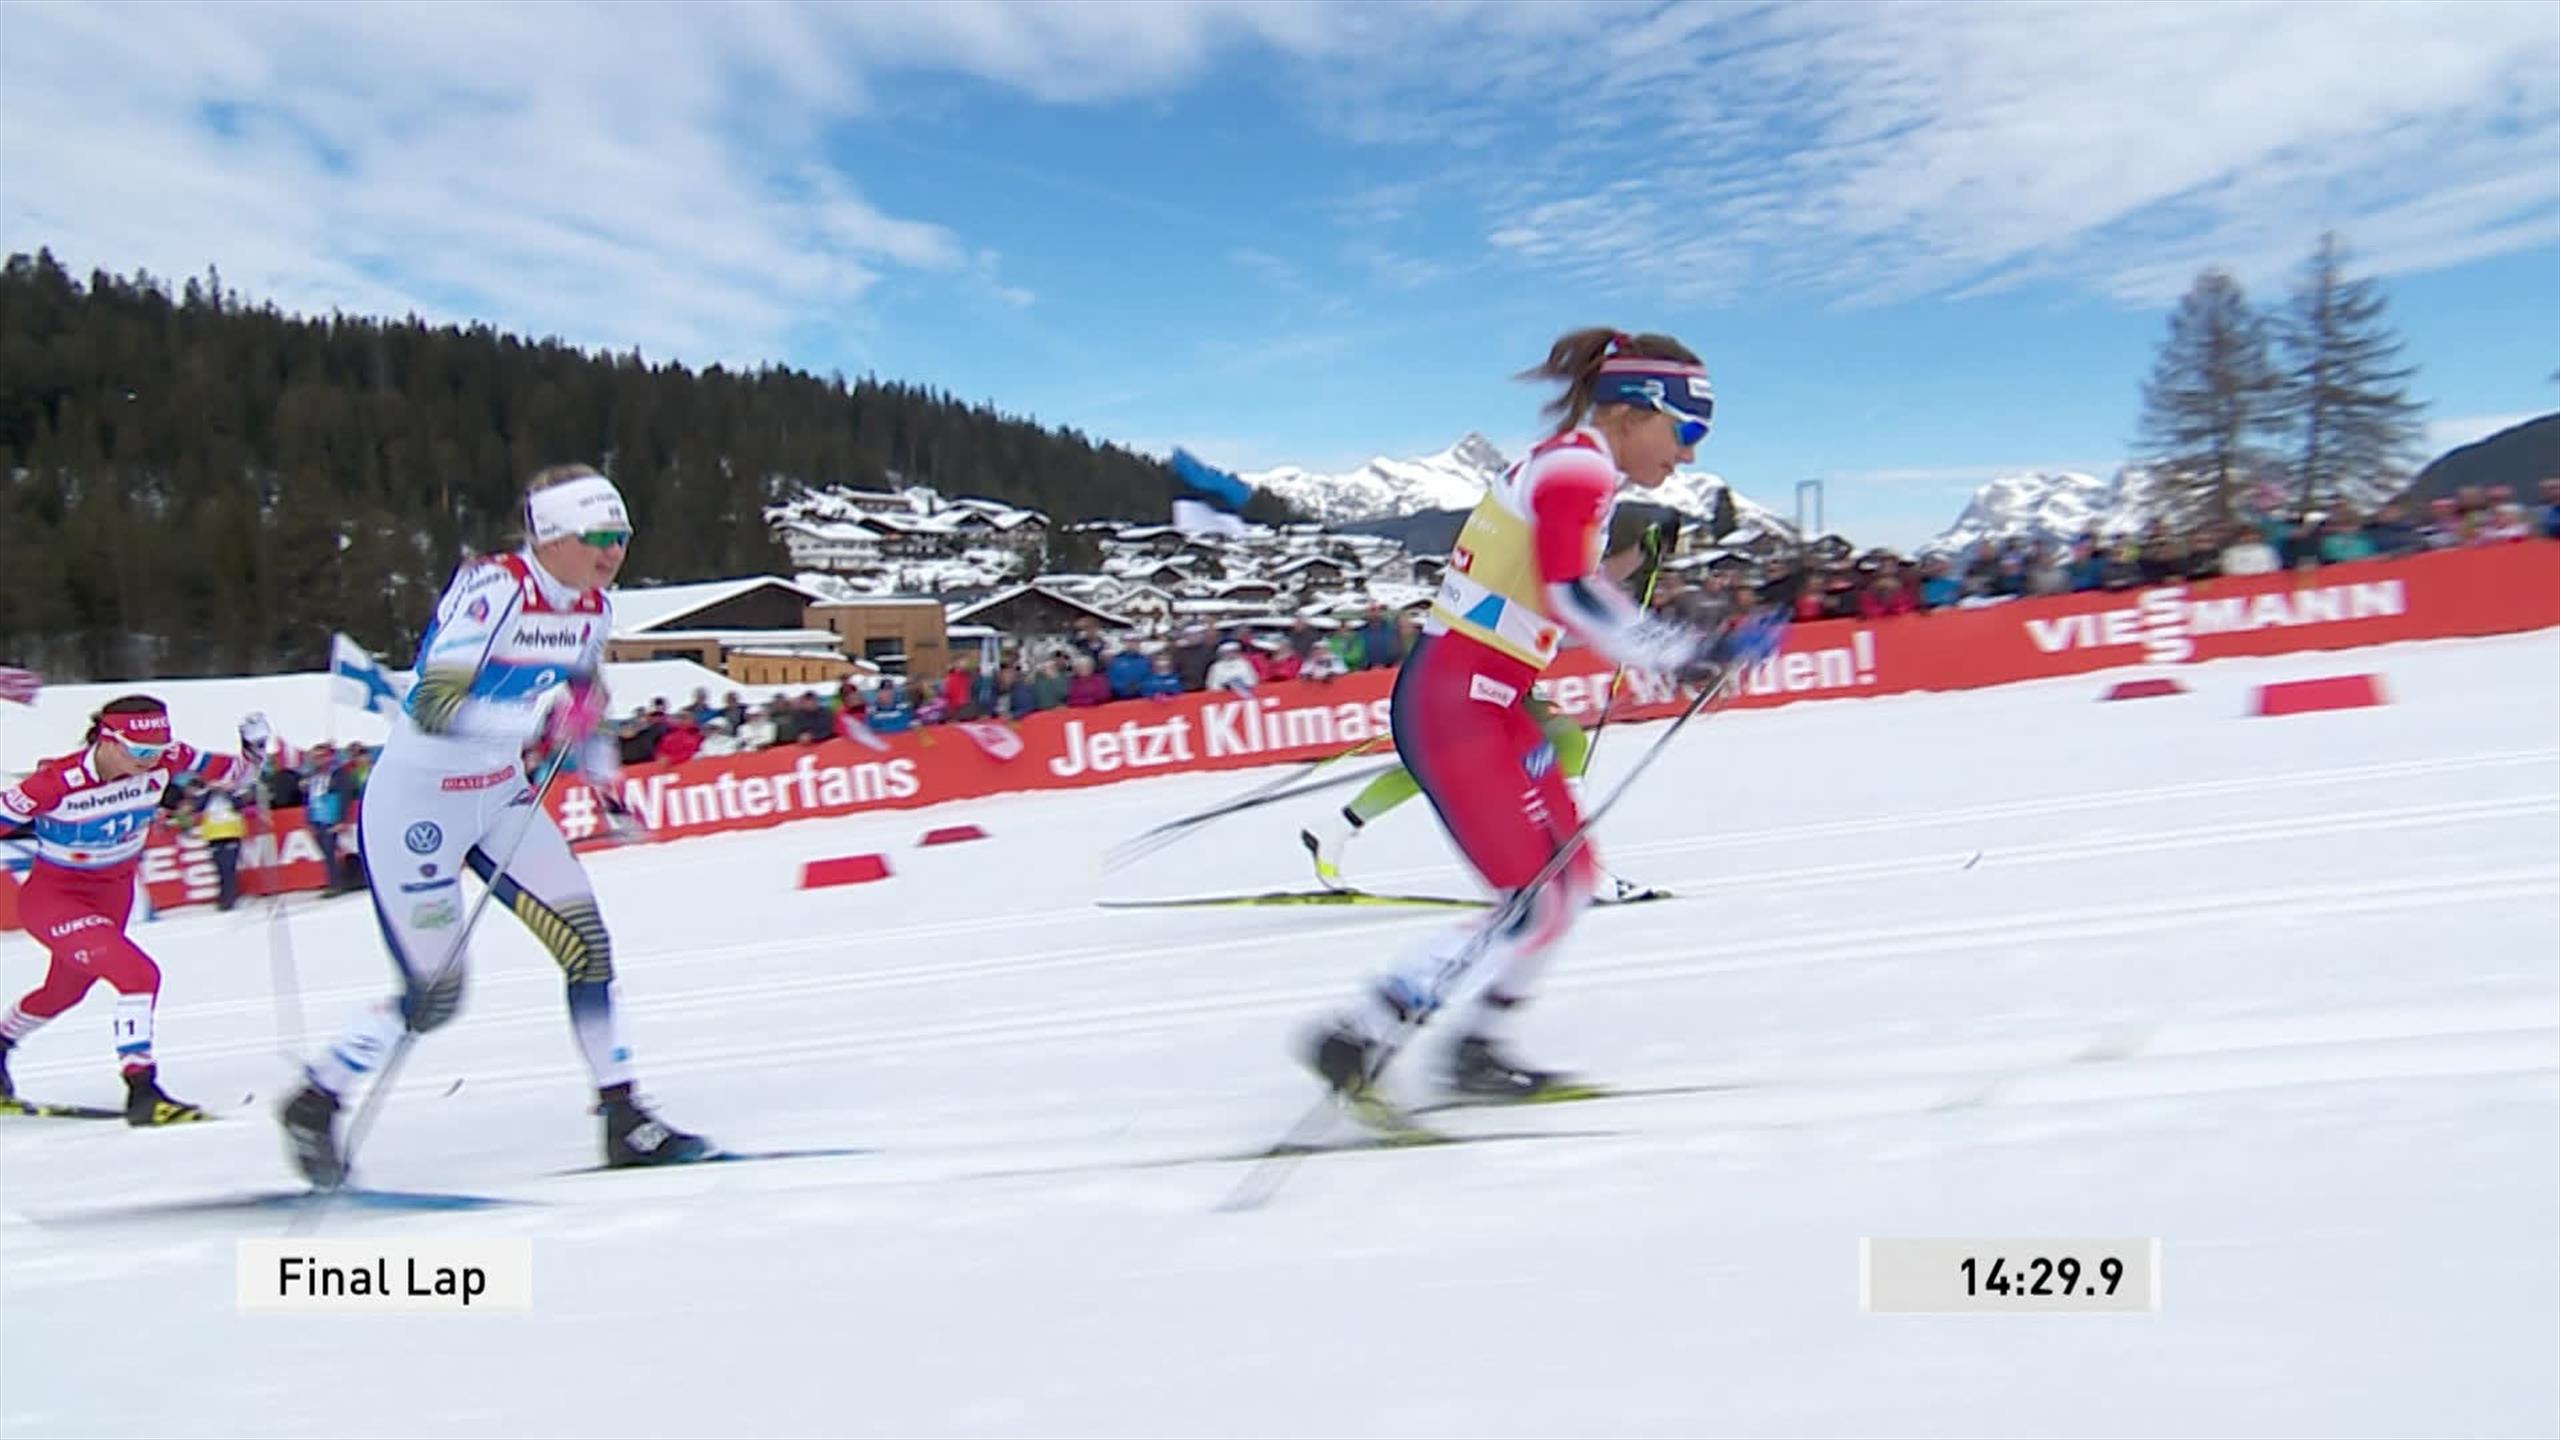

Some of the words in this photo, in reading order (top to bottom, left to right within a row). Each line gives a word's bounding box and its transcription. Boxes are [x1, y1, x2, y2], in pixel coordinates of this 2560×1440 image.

[2025, 580, 2405, 663] VIESSMANN
[513, 624, 577, 647] helvetia
[1050, 714, 1194, 777] Jetzt
[67, 786, 141, 811] helvetia
[100, 814, 133, 837] 11
